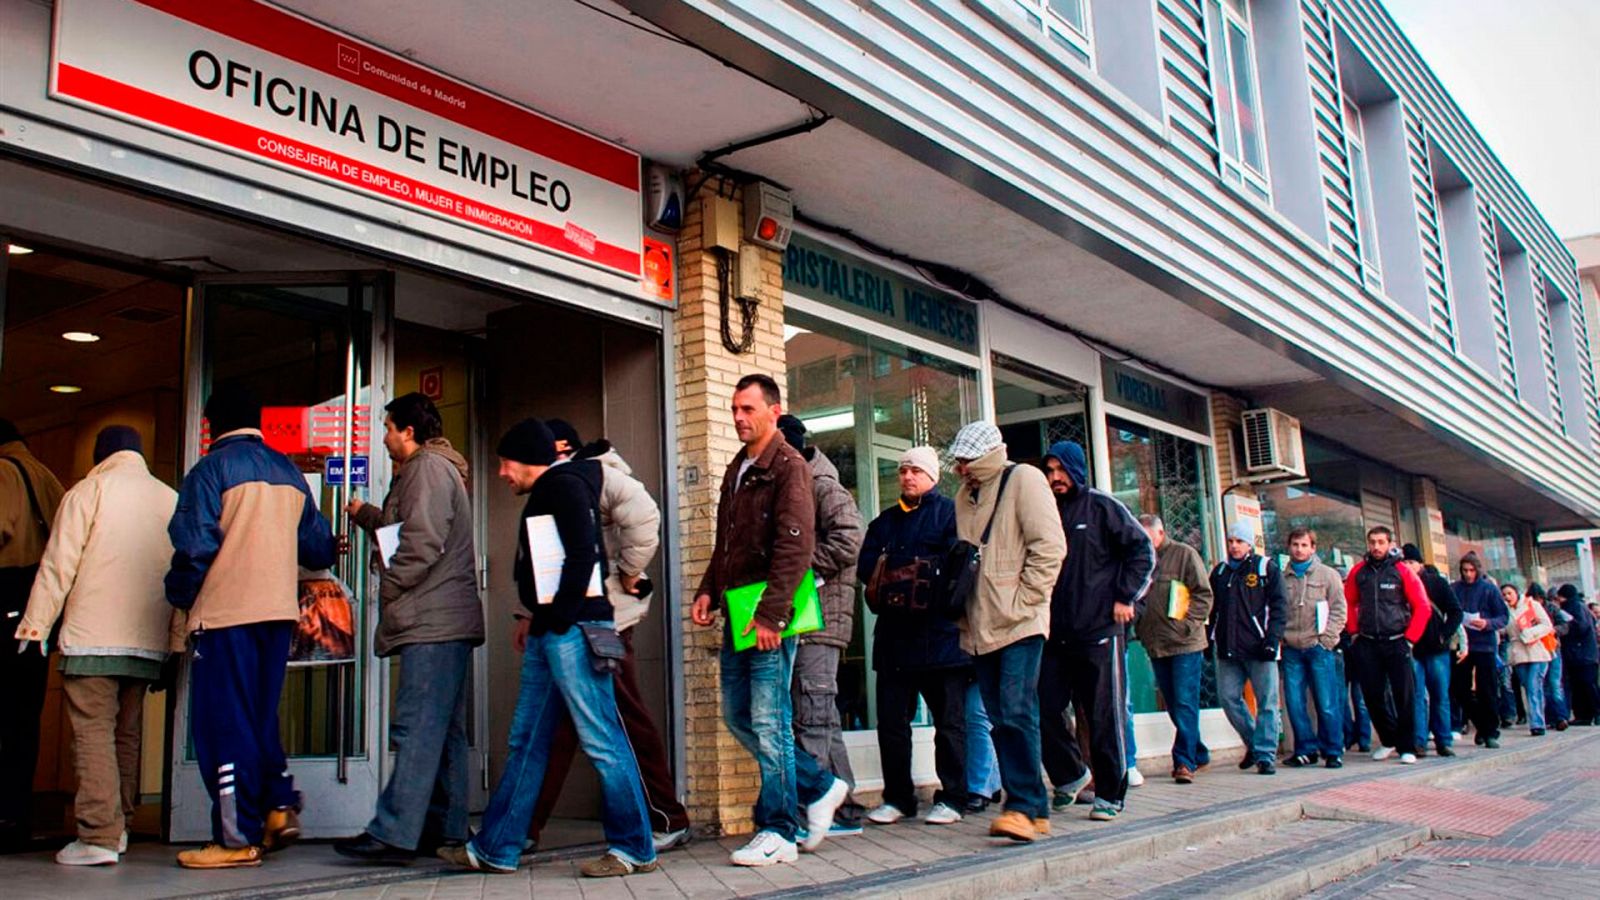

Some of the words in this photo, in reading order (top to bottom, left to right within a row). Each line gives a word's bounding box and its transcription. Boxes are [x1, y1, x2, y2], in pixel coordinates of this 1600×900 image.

[362, 61, 418, 90] Comunidad
[419, 83, 432, 96] de
[434, 88, 467, 109] Madrid
[188, 49, 366, 144] OFICINA
[377, 114, 426, 165] DE
[438, 136, 571, 213] EMPLEO
[257, 136, 339, 173] CONSEJERÍA
[341, 163, 359, 180] DE
[361, 169, 413, 198] EMPLEO,
[415, 187, 454, 210] MUJER
[455, 201, 463, 214] E
[464, 204, 533, 236] INMIGRACIÓN
[903, 286, 976, 346] MENESES
